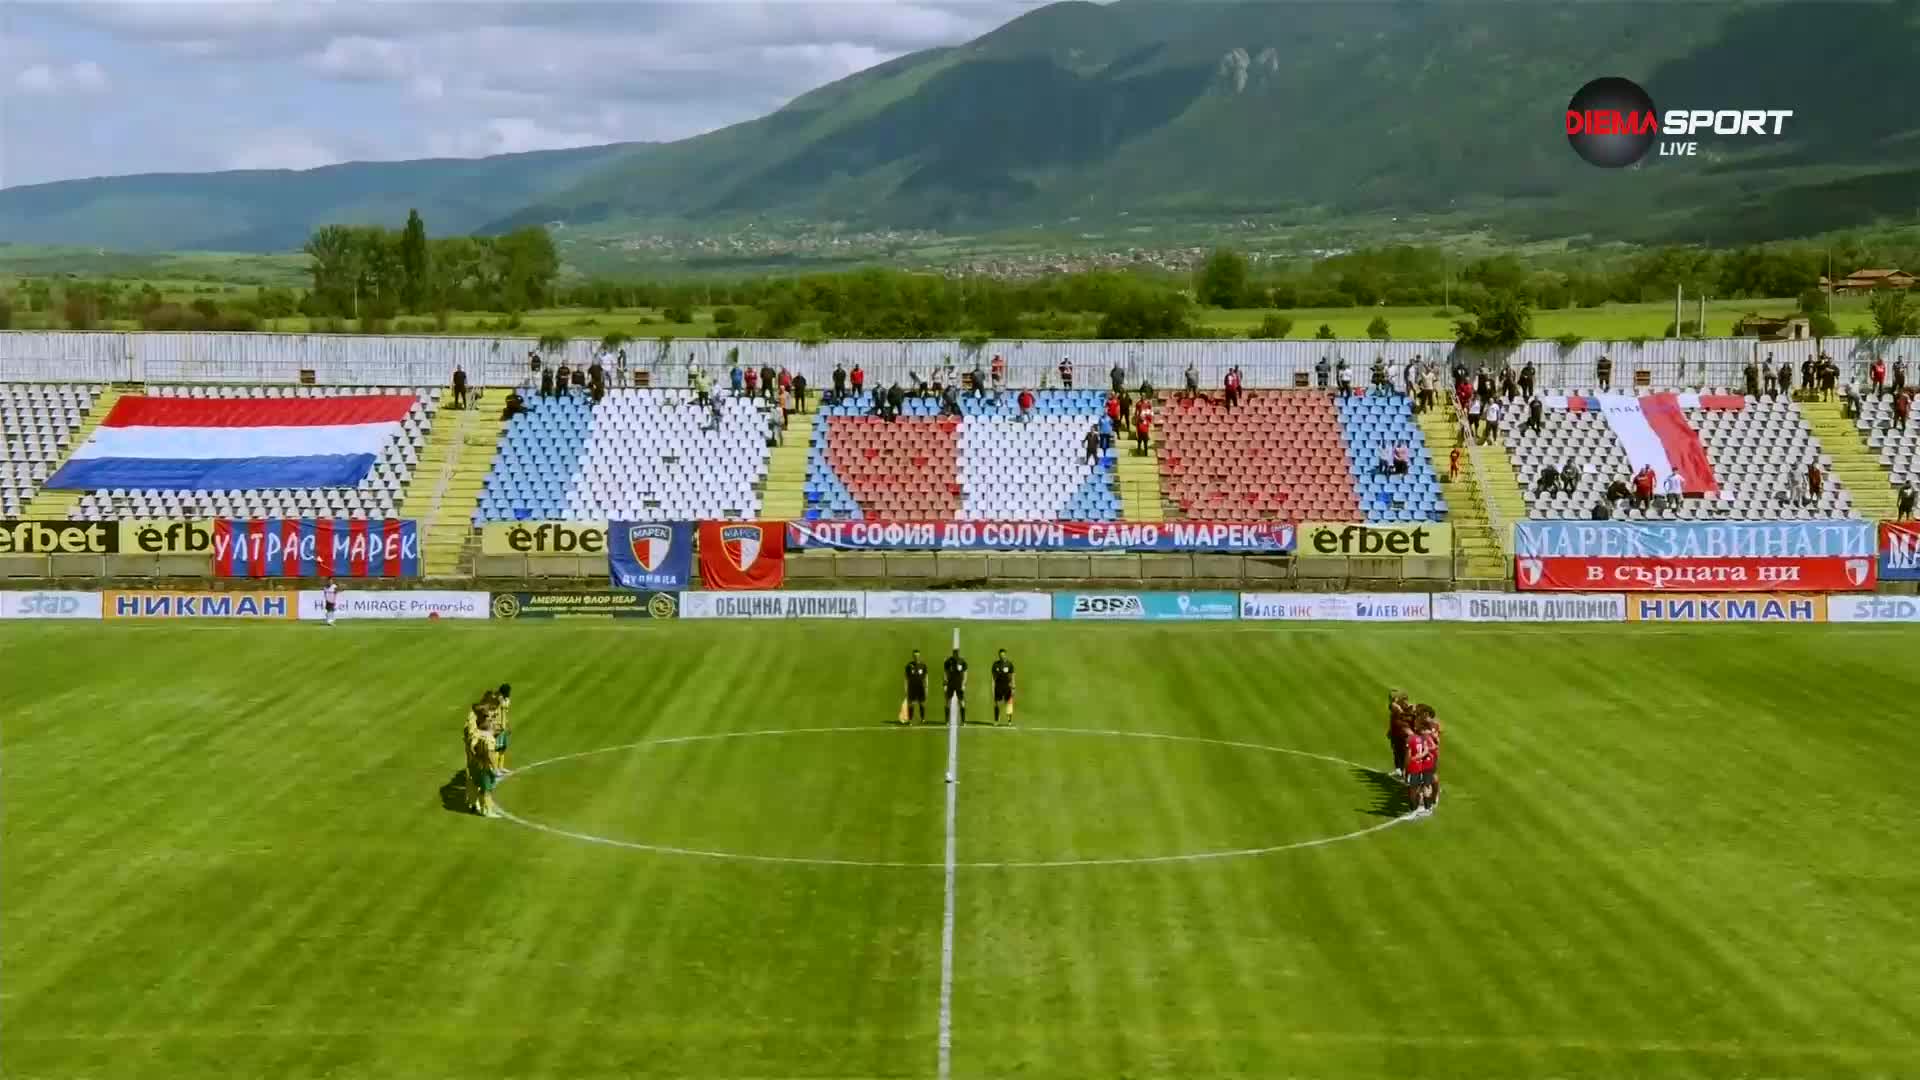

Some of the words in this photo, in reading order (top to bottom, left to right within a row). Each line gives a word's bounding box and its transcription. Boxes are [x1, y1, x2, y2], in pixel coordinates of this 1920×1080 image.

[507, 524, 607, 551] efbe
[633, 528, 667, 538] МАРЕК
[816, 523, 842, 545] ОТ
[852, 523, 935, 546] СОФИЯ
[942, 523, 976, 547] ДО
[983, 523, 1064, 546] СОЛУН
[1088, 523, 1158, 546] САМО
[1165, 523, 1268, 546] "МАРЕК"
[1312, 525, 1430, 554] efbet
[1520, 526, 1646, 558] МАРЕК
[1655, 526, 1868, 558] ЗАВИНАГИ
[214, 533, 316, 561] УЛТРАС
[332, 532, 417, 560] МАРЕК
[1587, 567, 1604, 581] в
[1614, 567, 1748, 588] сърцата
[1757, 567, 1801, 581] ни
[117, 596, 285, 615] НИКМАН
[354, 600, 407, 612] MIRAGE
[411, 600, 475, 613] Primorsko
[529, 596, 581, 604] АМЕРИКАН
[715, 598, 782, 616] ОБЩИНА
[785, 598, 858, 618] ДУПНИЦА
[1470, 599, 1539, 619] ОБЩИНА
[1543, 599, 1618, 619] ДУПНИЦА
[1640, 600, 1812, 619] НИКМАН
[1263, 605, 1285, 617] ЛЕВ
[1289, 605, 1312, 617] ИНС
[1376, 605, 1398, 617] ЛЕВ
[1402, 605, 1425, 617] ИНС
